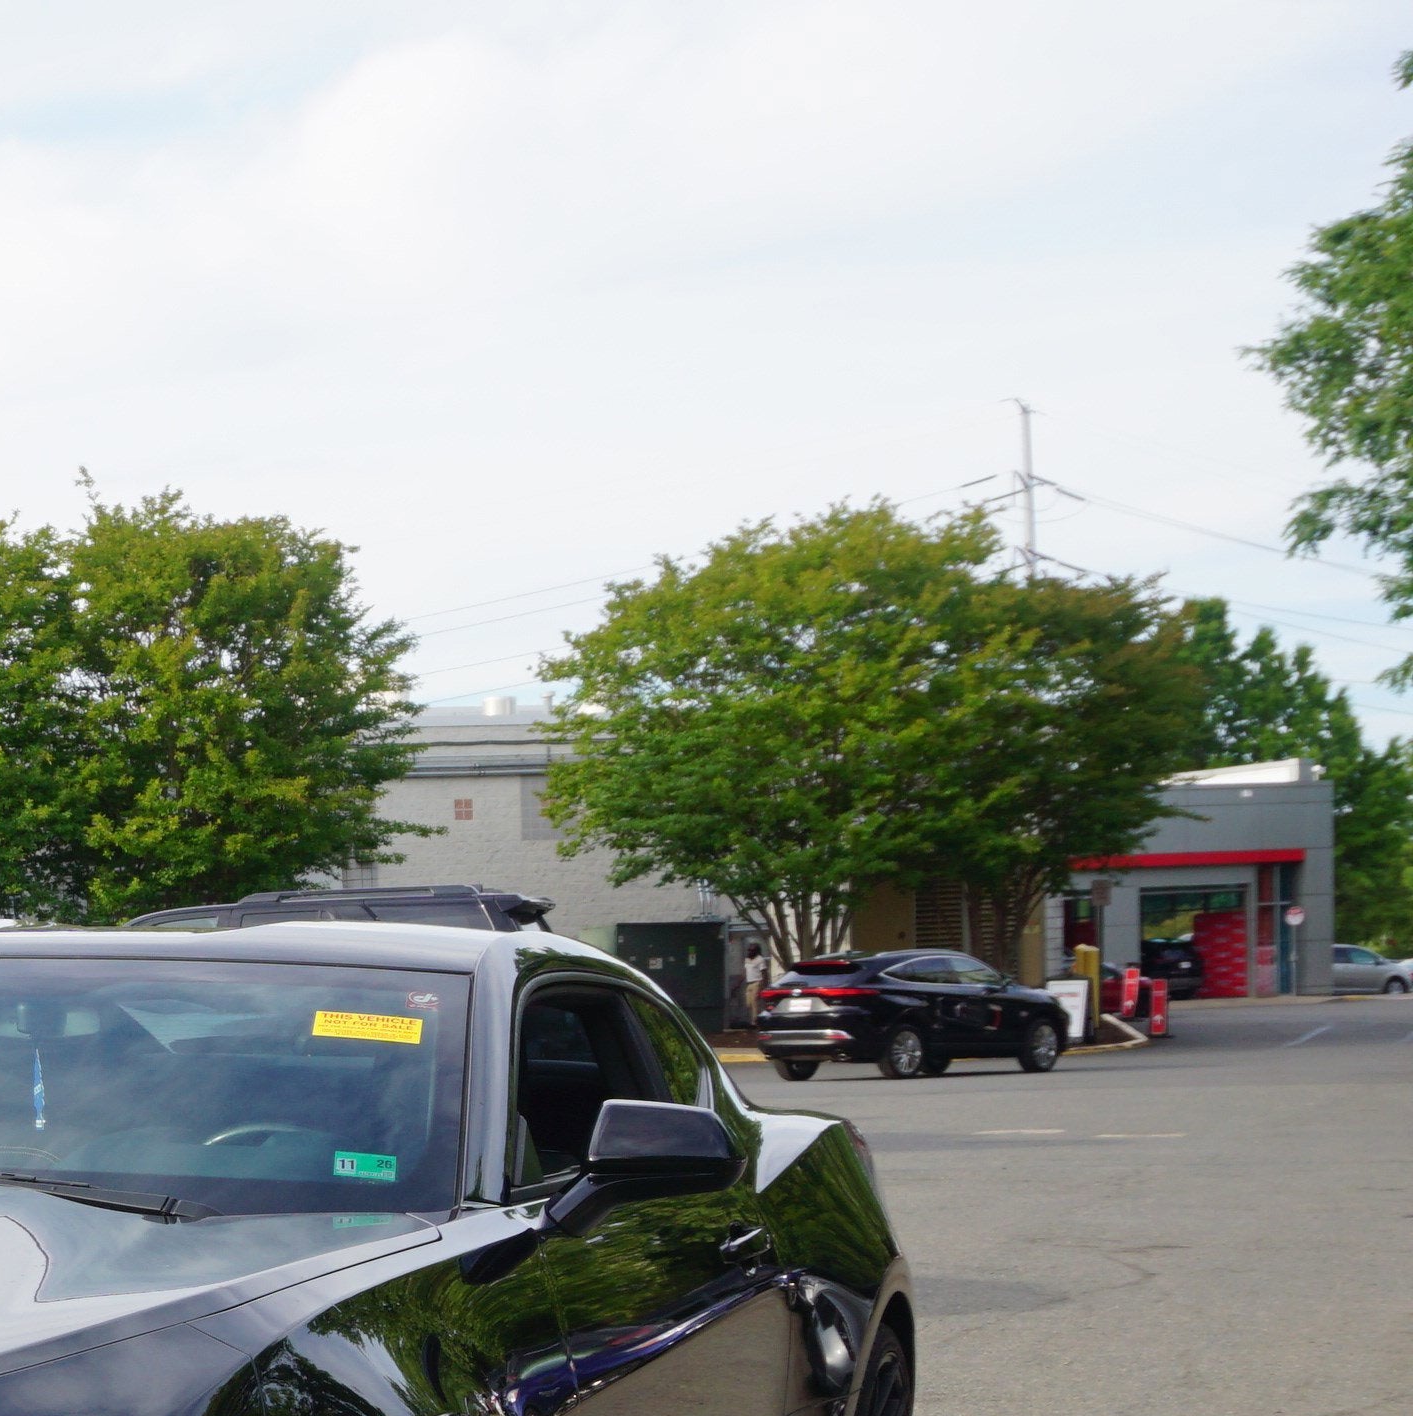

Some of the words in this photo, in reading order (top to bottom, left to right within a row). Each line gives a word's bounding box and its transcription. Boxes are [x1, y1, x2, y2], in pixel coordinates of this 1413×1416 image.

[322, 1012, 353, 1020] THIS
[358, 1015, 417, 1026] VEHICLE
[382, 1023, 414, 1031] SALE
[339, 1159, 355, 1170] 11
[376, 1160, 393, 1169] 26
